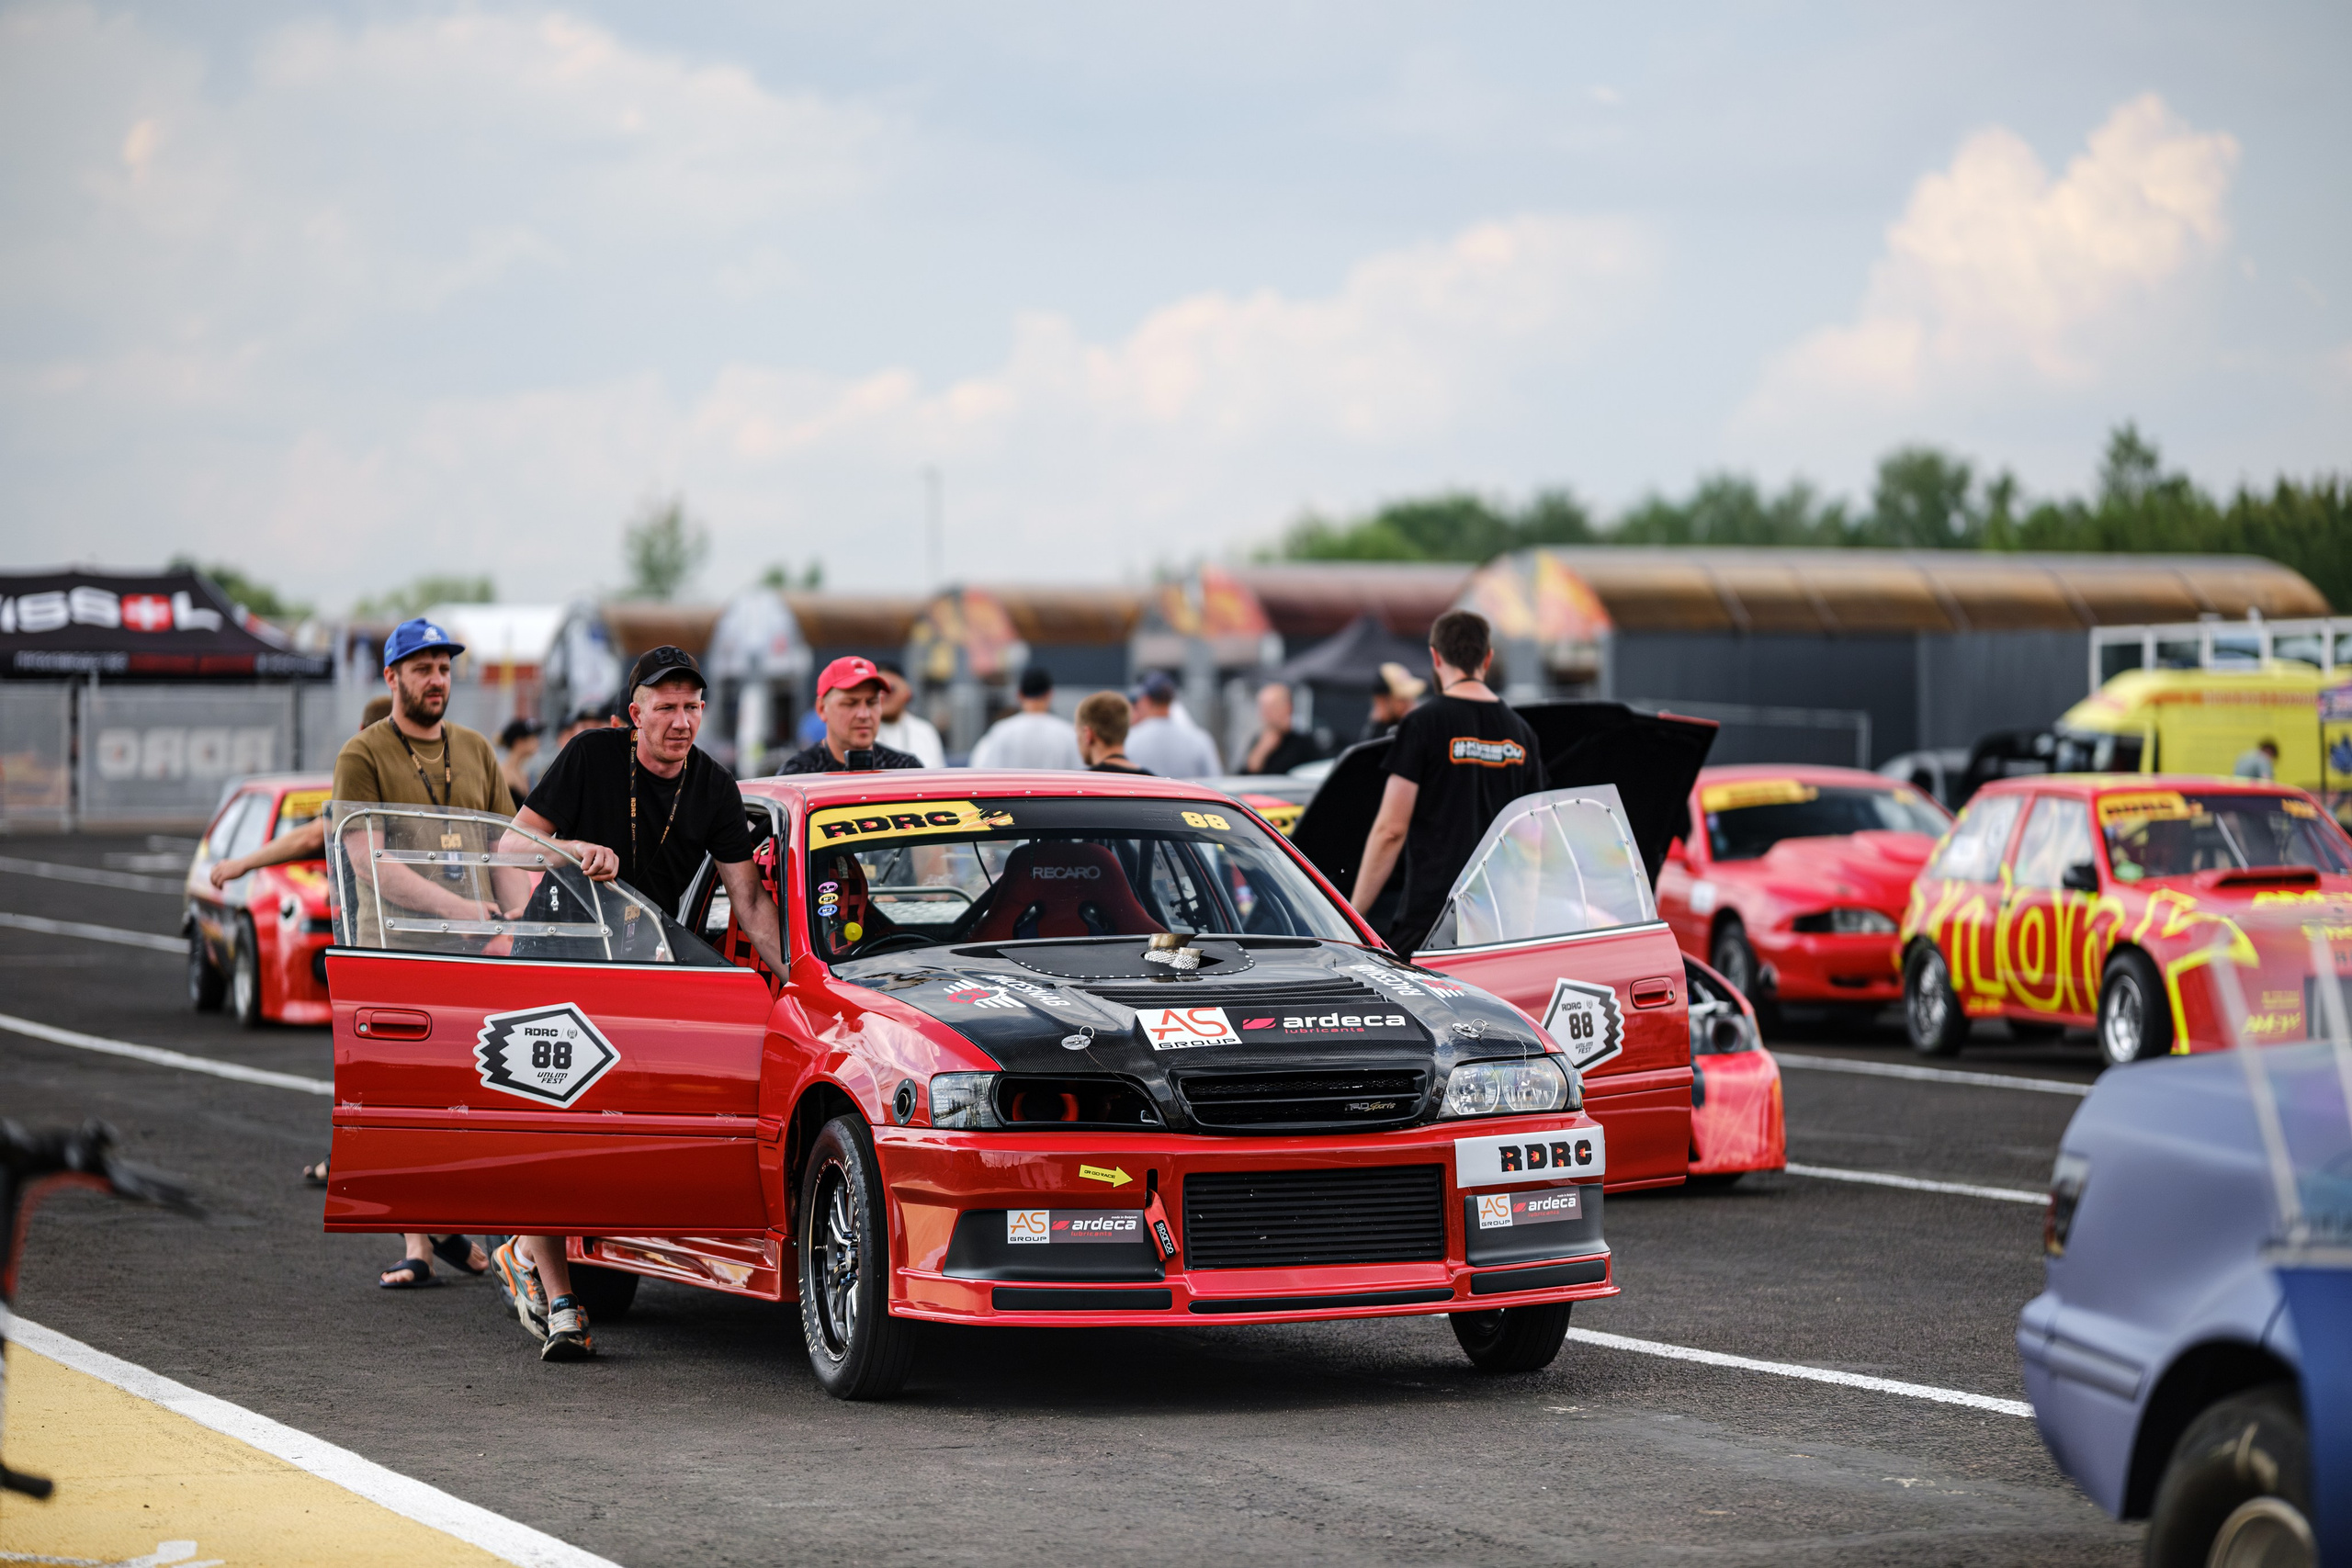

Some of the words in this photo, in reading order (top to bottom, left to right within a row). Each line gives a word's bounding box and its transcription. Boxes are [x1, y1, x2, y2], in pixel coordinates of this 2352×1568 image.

[817, 811, 961, 839] RDRC
[1181, 811, 1231, 830] 88
[1033, 865, 1102, 879] RECARO
[1561, 1001, 1582, 1011] RDRC
[1149, 1007, 1228, 1040] AS
[1283, 1012, 1407, 1028] ardeca
[1568, 1011, 1594, 1040] 88
[525, 1027, 559, 1037] RDRC
[1159, 1038, 1237, 1049] GROUP
[532, 1040, 572, 1069] 88
[1364, 1101, 1396, 1112] Sports
[1498, 1139, 1592, 1172] RDRC
[1480, 1196, 1509, 1219] AS
[1528, 1196, 1577, 1212] ardeca
[1010, 1212, 1046, 1234] AS
[1071, 1217, 1136, 1231] ardeca
[1481, 1219, 1511, 1227] GROUP
[1157, 1222, 1174, 1255] sparco
